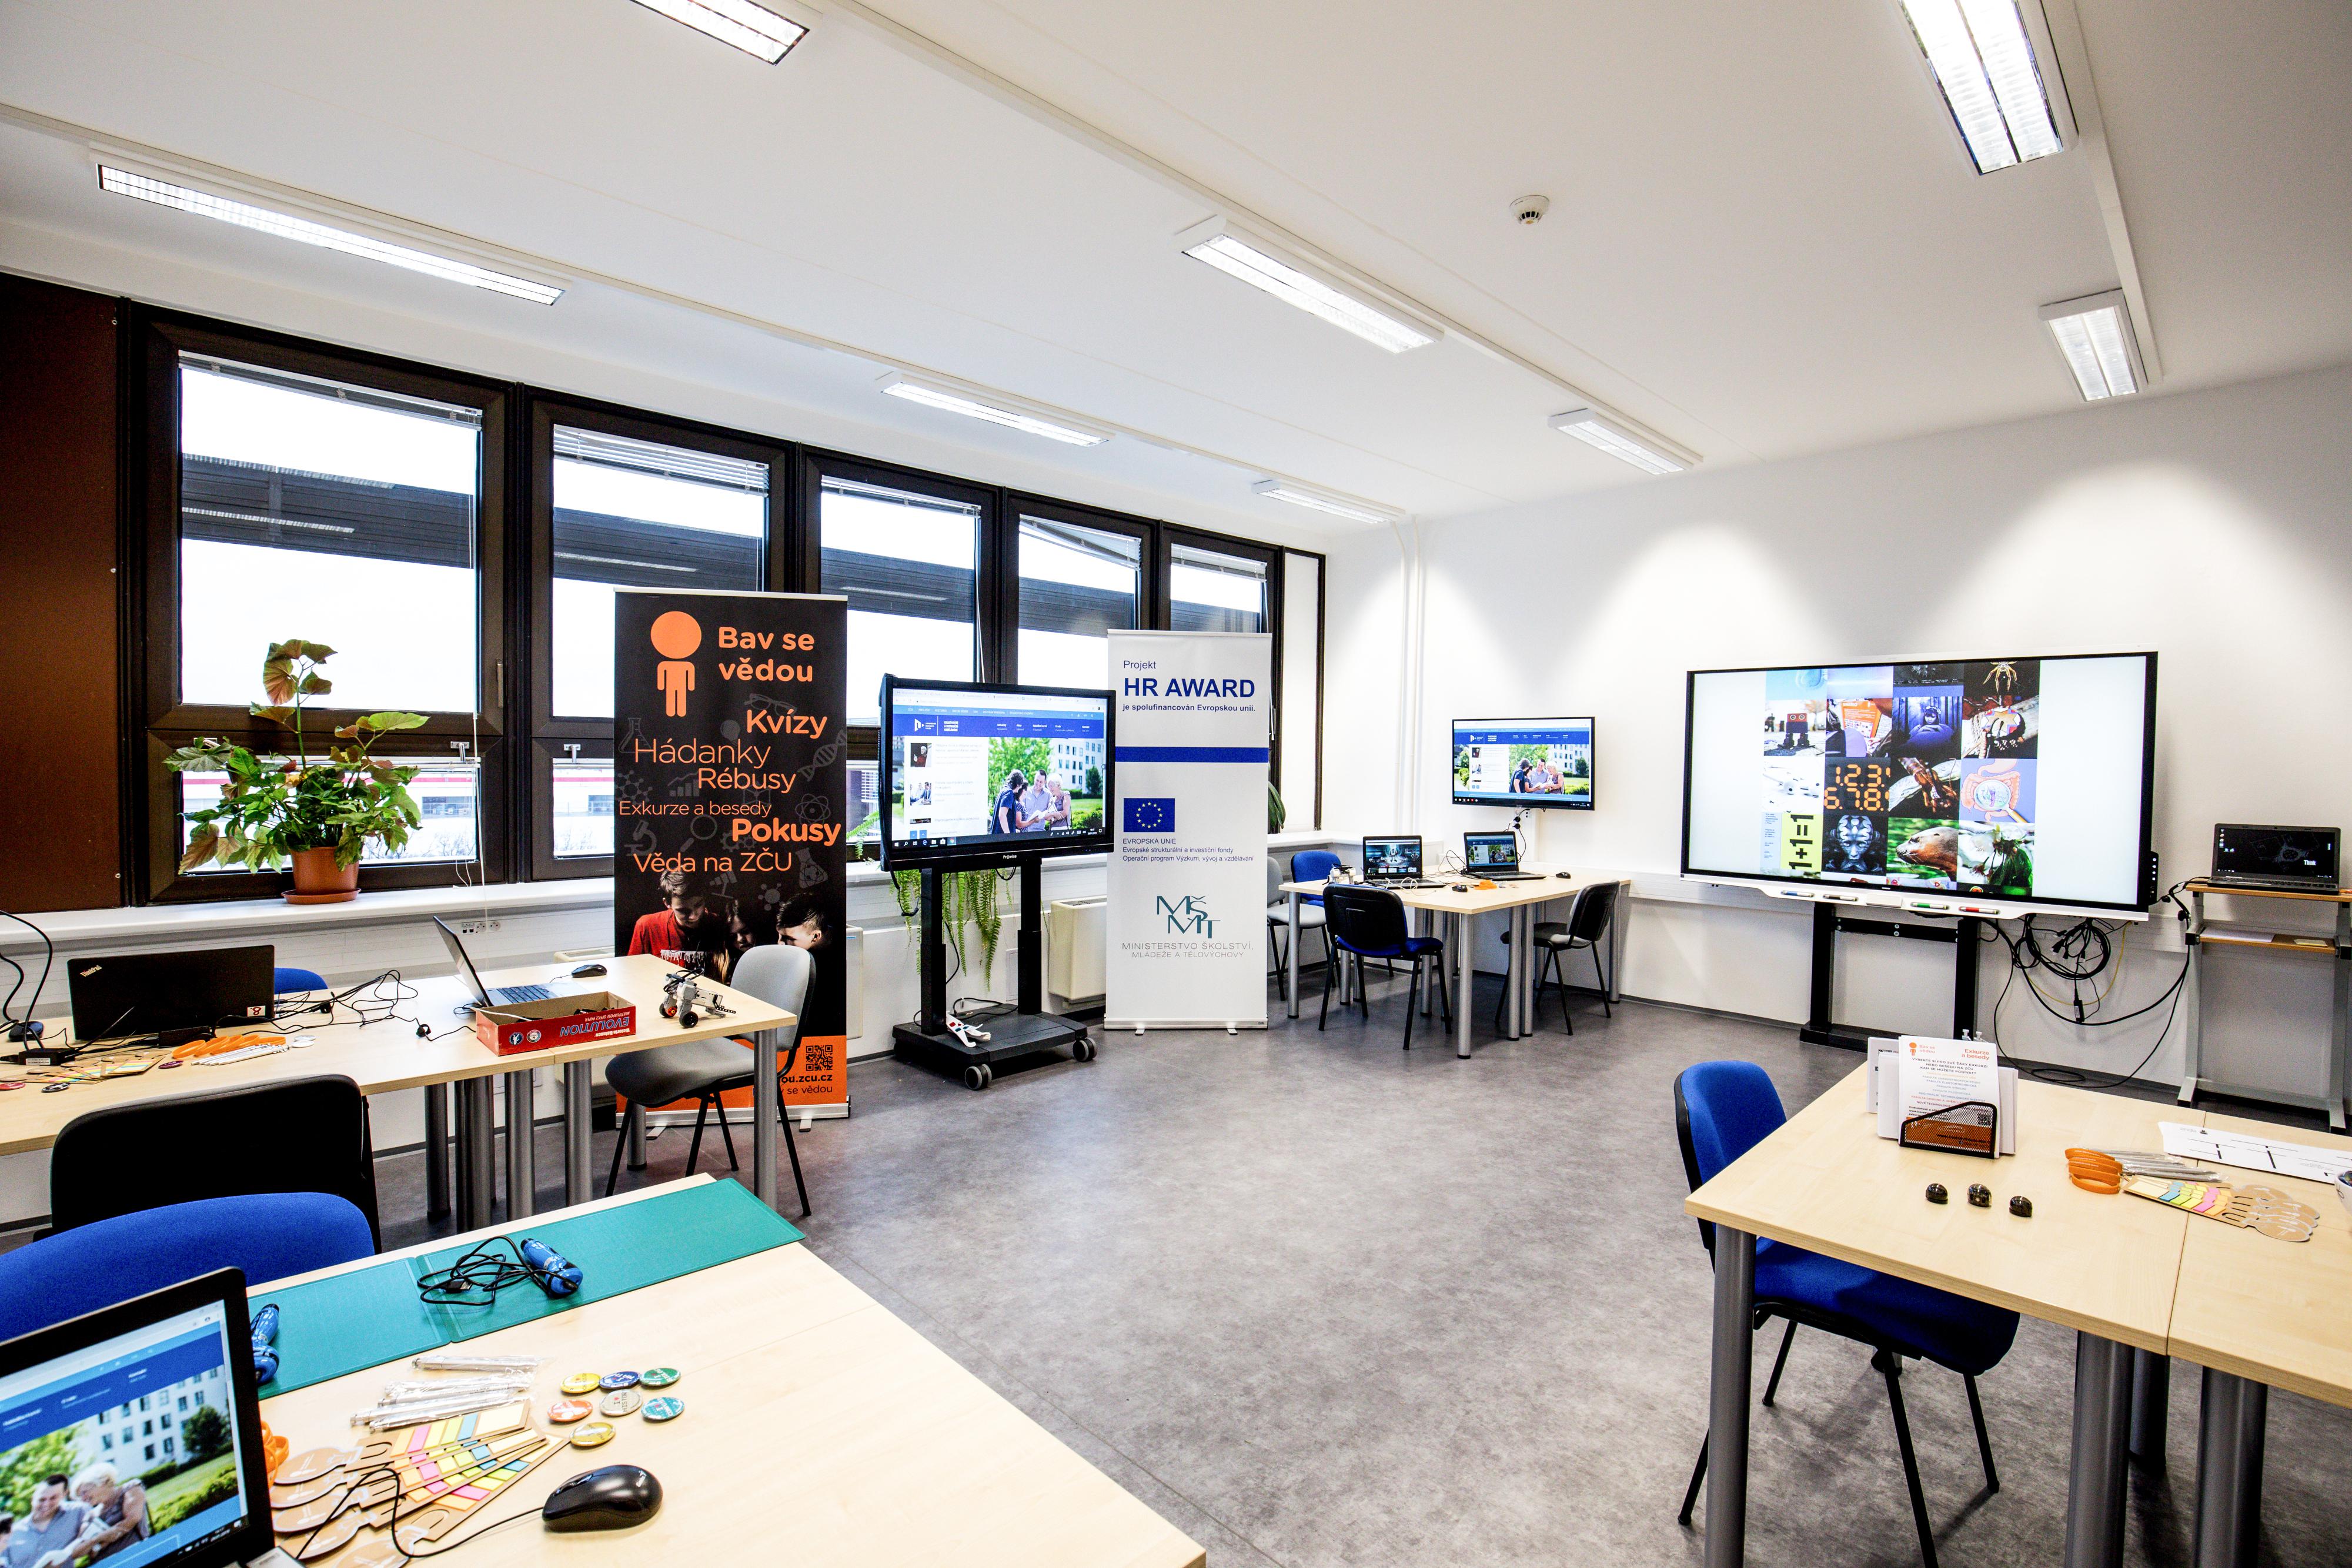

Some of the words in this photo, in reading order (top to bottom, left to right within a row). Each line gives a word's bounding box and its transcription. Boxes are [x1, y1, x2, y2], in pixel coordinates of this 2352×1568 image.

[719, 627, 774, 649] Bav
[783, 633, 814, 650] se
[719, 657, 813, 681] vědou
[1124, 660, 1156, 670] Projekt
[1125, 678, 1158, 696] HR
[1165, 678, 1255, 697] AWARD
[747, 708, 827, 739] Kvízy
[635, 738, 771, 768] Hádanky
[699, 768, 796, 793] Rébusy
[619, 801, 689, 815] Exkurze
[694, 804, 704, 815] a
[710, 801, 771, 818] besedy
[732, 818, 841, 846] Pokusy
[633, 852, 696, 872] Věda
[704, 857, 731, 872] na
[740, 848, 791, 871] ZČU
[1202, 941, 1254, 951] ŠKOLSTVÍ,
[605, 1011, 630, 1020] MULTIPURPOSE
[560, 1017, 629, 1037] EVOLUTION
[801, 1085, 833, 1094] vědou
